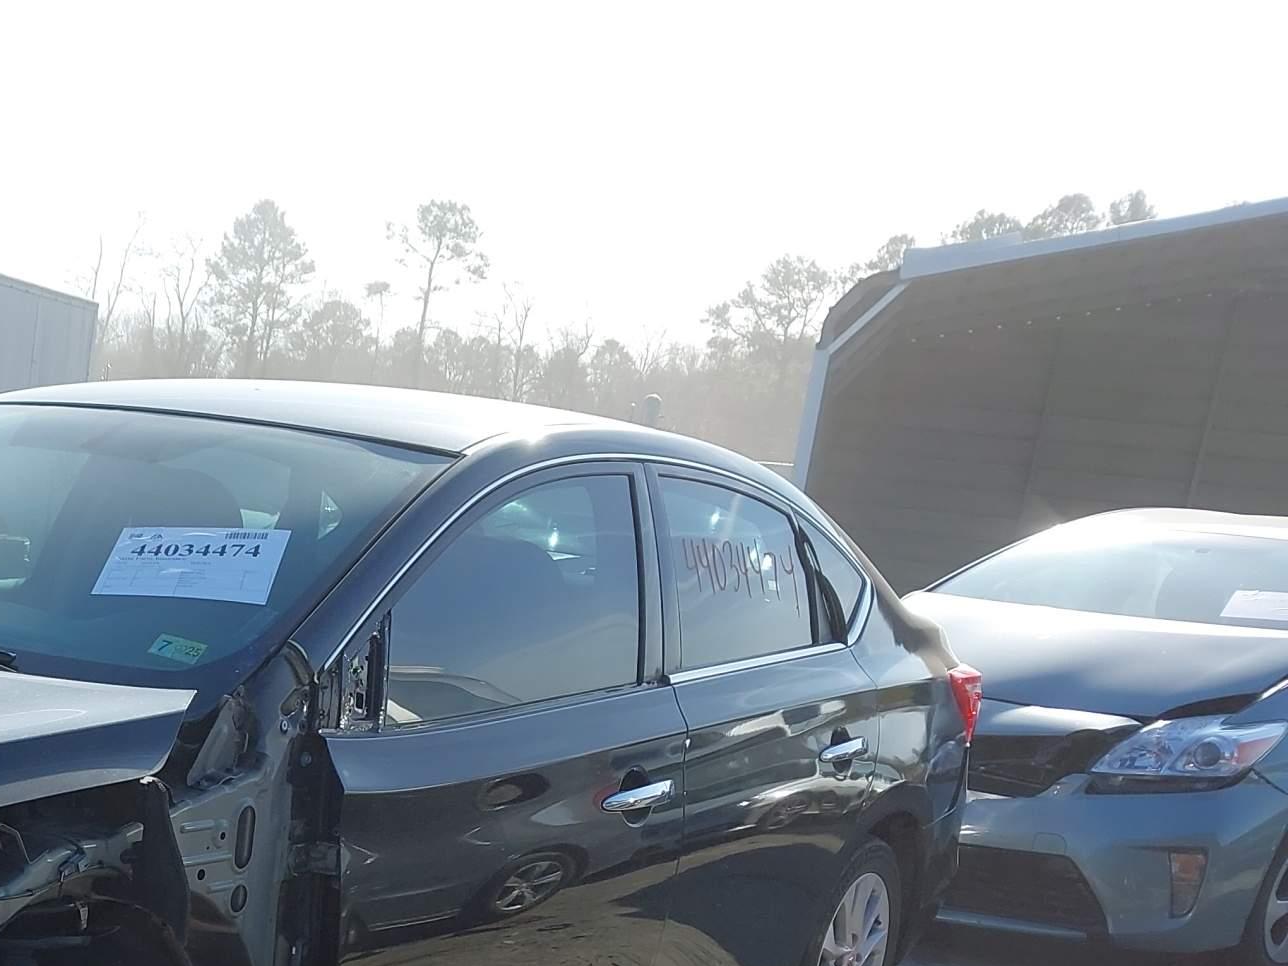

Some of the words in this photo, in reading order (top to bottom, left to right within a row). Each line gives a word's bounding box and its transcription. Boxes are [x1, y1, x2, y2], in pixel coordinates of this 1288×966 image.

[130, 543, 261, 558] 44034474
[682, 538, 800, 617] 44034474
[157, 639, 173, 652] 7
